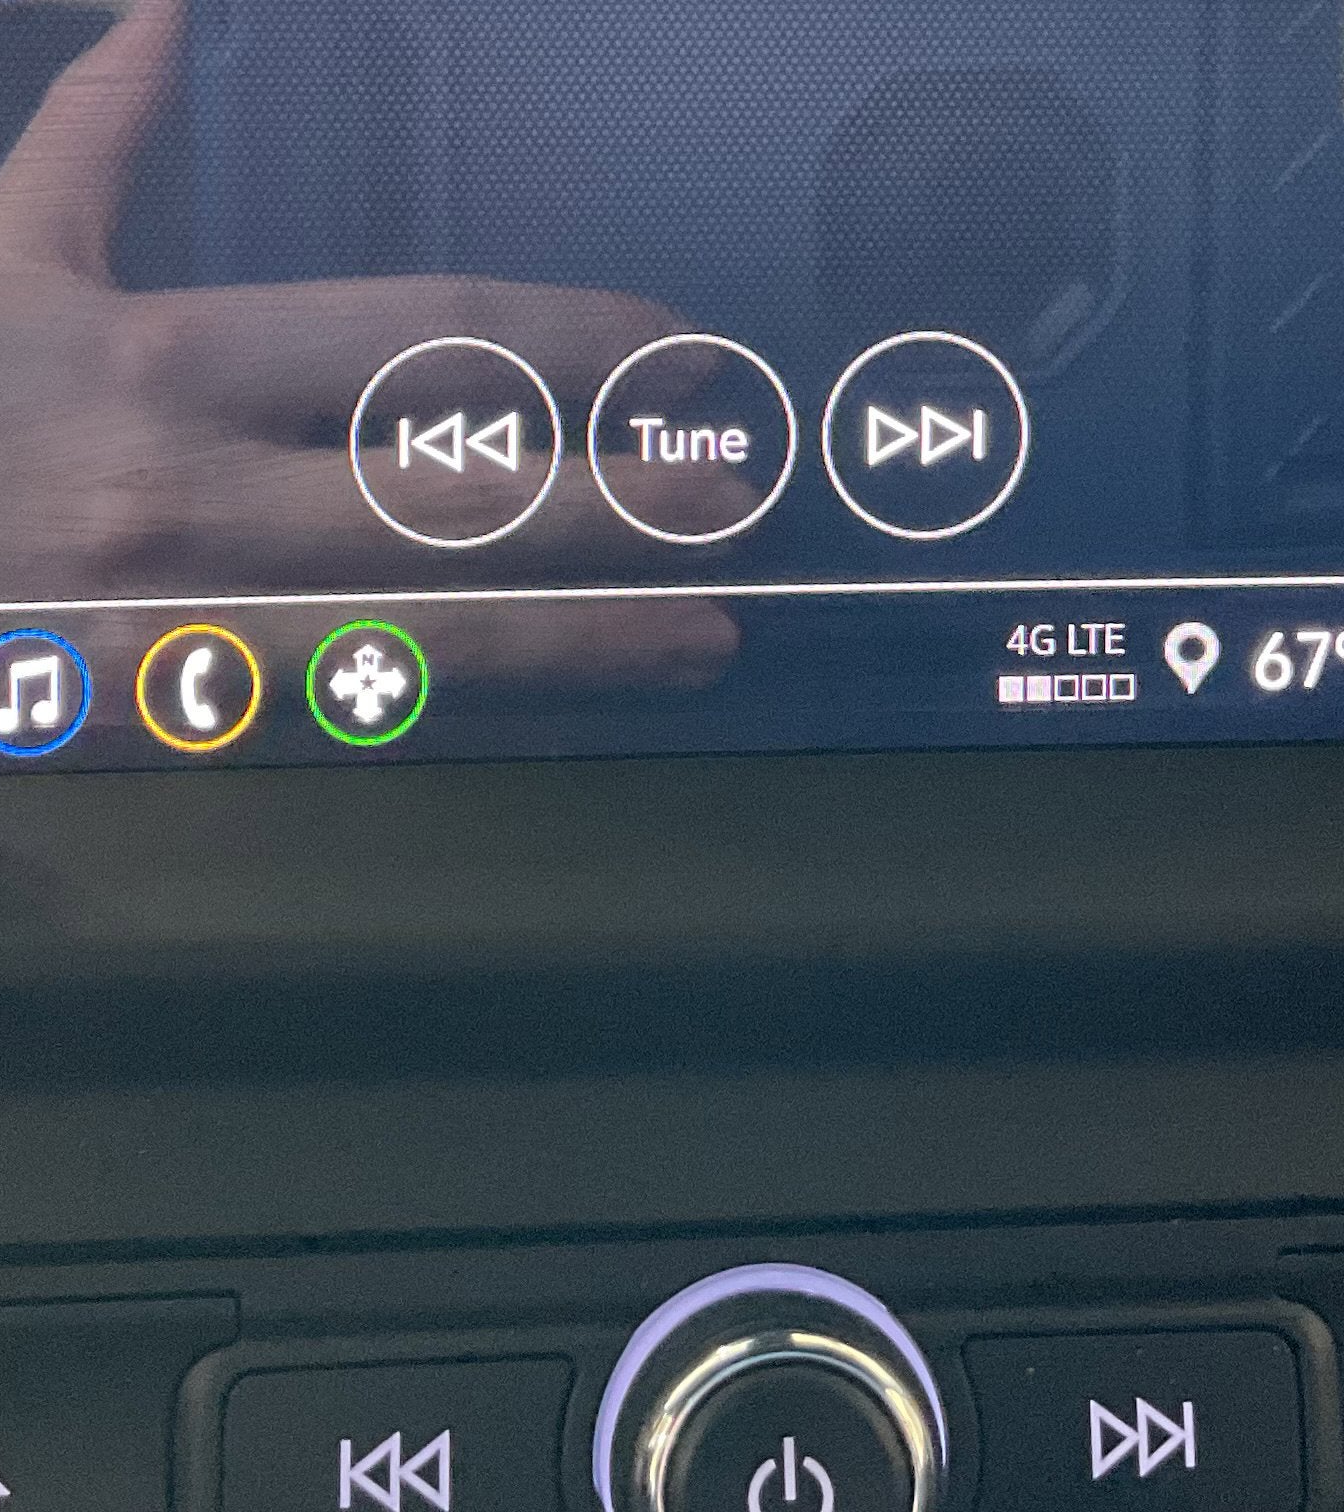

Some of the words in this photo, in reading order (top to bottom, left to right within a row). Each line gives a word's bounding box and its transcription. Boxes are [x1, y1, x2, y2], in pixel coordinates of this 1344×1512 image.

[629, 418, 748, 462] Tune
[1006, 624, 1056, 656] 4G
[1068, 623, 1125, 655] LTE
